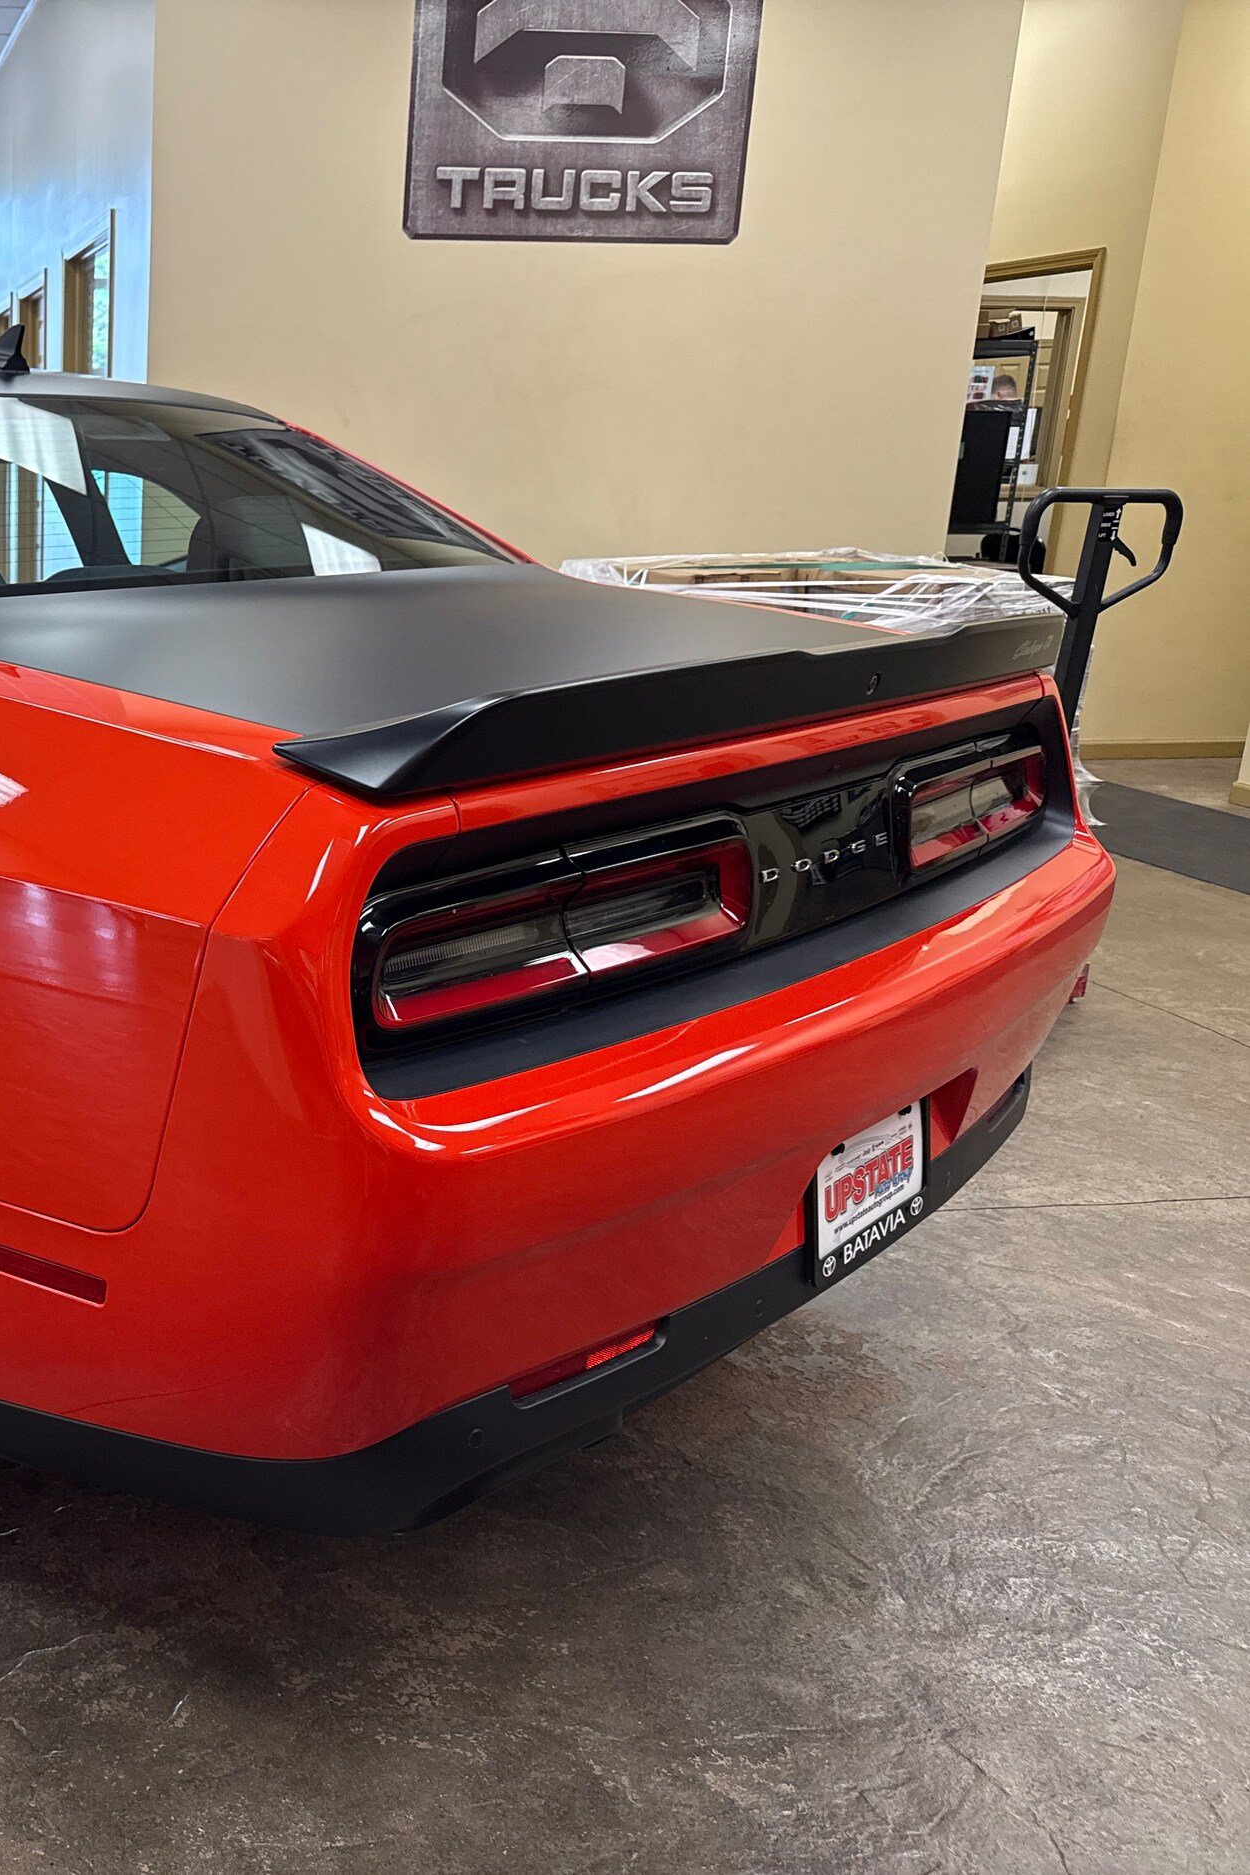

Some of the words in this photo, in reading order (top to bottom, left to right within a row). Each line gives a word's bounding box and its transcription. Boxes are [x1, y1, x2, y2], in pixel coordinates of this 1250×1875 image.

[436, 166, 714, 213] TRUCKS
[761, 832, 888, 883] DODGE
[824, 1134, 914, 1222] UPSTATE
[843, 1208, 906, 1265] BATAVIA
